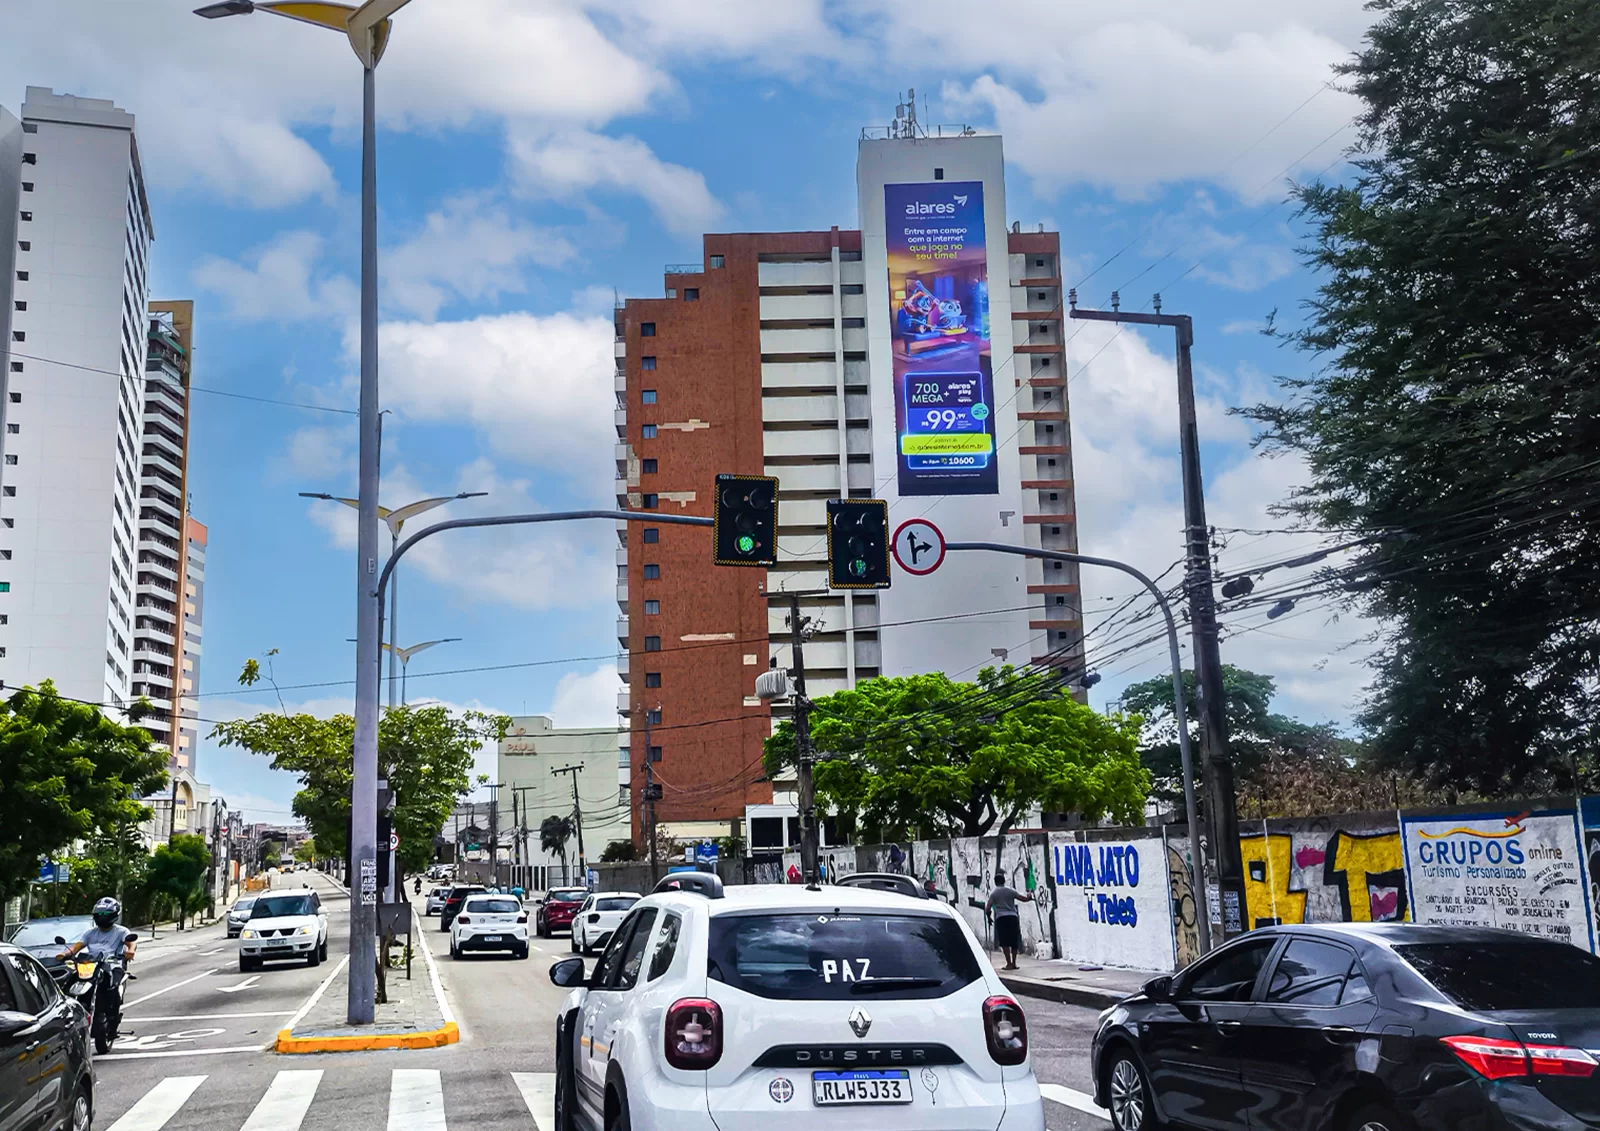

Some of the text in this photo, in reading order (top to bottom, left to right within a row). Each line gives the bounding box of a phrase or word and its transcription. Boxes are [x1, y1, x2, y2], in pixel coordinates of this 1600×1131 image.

[906, 201, 955, 214] alares
[910, 244, 927, 253] que
[929, 243, 949, 253] joga
[934, 251, 957, 260] time!
[915, 383, 939, 394] 700
[912, 394, 943, 403] MEGA
[927, 410, 956, 429] 99
[1528, 843, 1562, 860] online
[1054, 844, 1139, 887] LAVA JATO
[1422, 865, 1526, 879] Turismo Personalizado
[1466, 884, 1518, 897] EXCURSÕES
[1098, 893, 1137, 928] Teles
[822, 958, 873, 983] PAZ
[796, 1049, 926, 1061] DUSTER
[823, 1080, 902, 1101] RLW5J33
